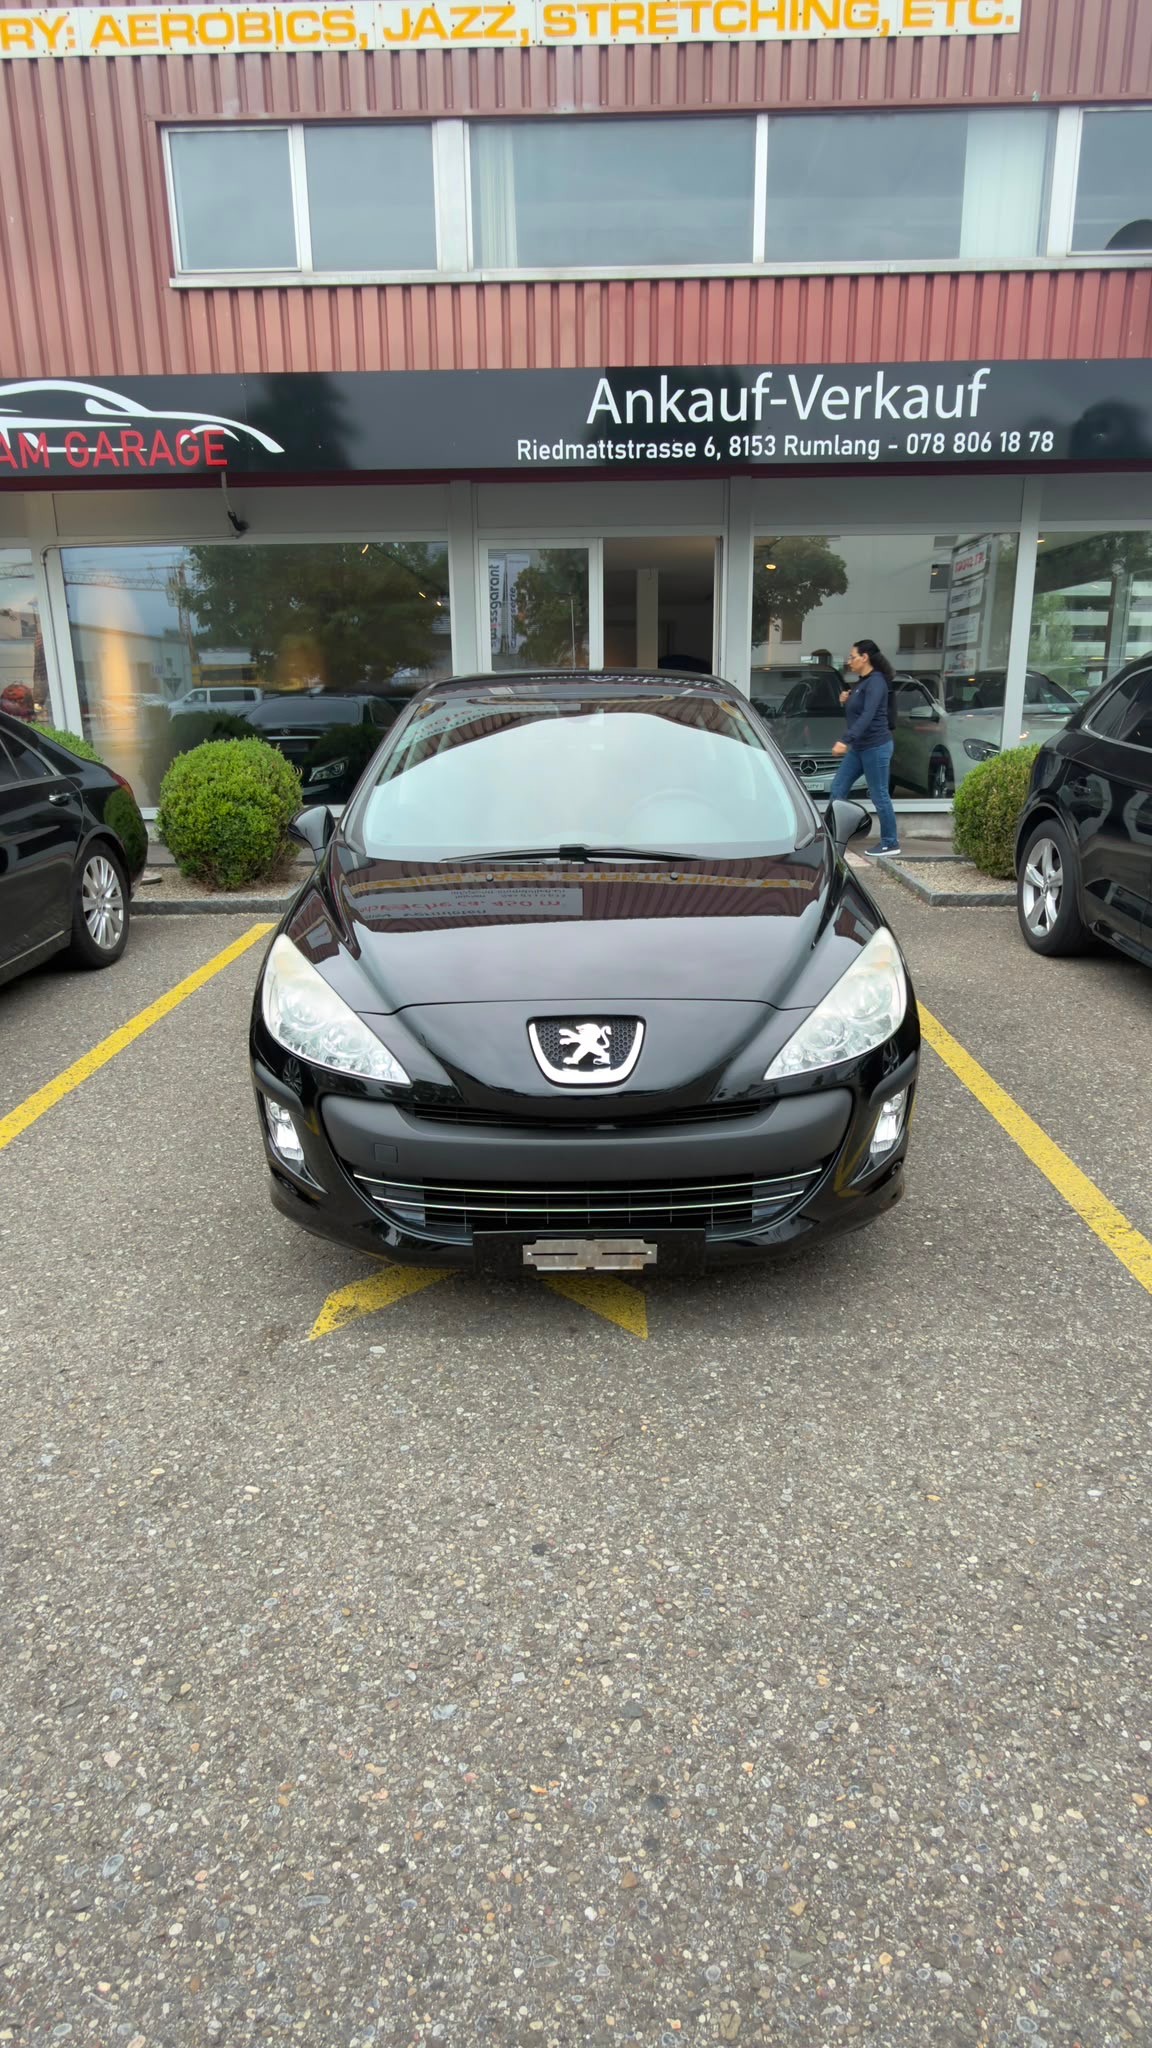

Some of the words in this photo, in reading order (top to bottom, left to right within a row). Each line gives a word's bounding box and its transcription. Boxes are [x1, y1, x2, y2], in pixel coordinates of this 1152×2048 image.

[91, 11, 369, 51] AEROBICS,
[384, 4, 531, 49] JAZZ,
[544, 0, 892, 39] STRETCHING,
[902, 0, 1015, 29] ETC.
[587, 368, 992, 425] Ankauf-Verkauf
[66, 430, 229, 470] GARAGE
[518, 438, 698, 462] Riedmattstrasse
[705, 437, 722, 461] 6,
[730, 435, 777, 459] 8153
[785, 435, 881, 462] Rumlang
[907, 433, 946, 456] 078
[954, 432, 993, 455] 806
[1001, 432, 1022, 454] 18
[1030, 431, 1055, 453] 78
